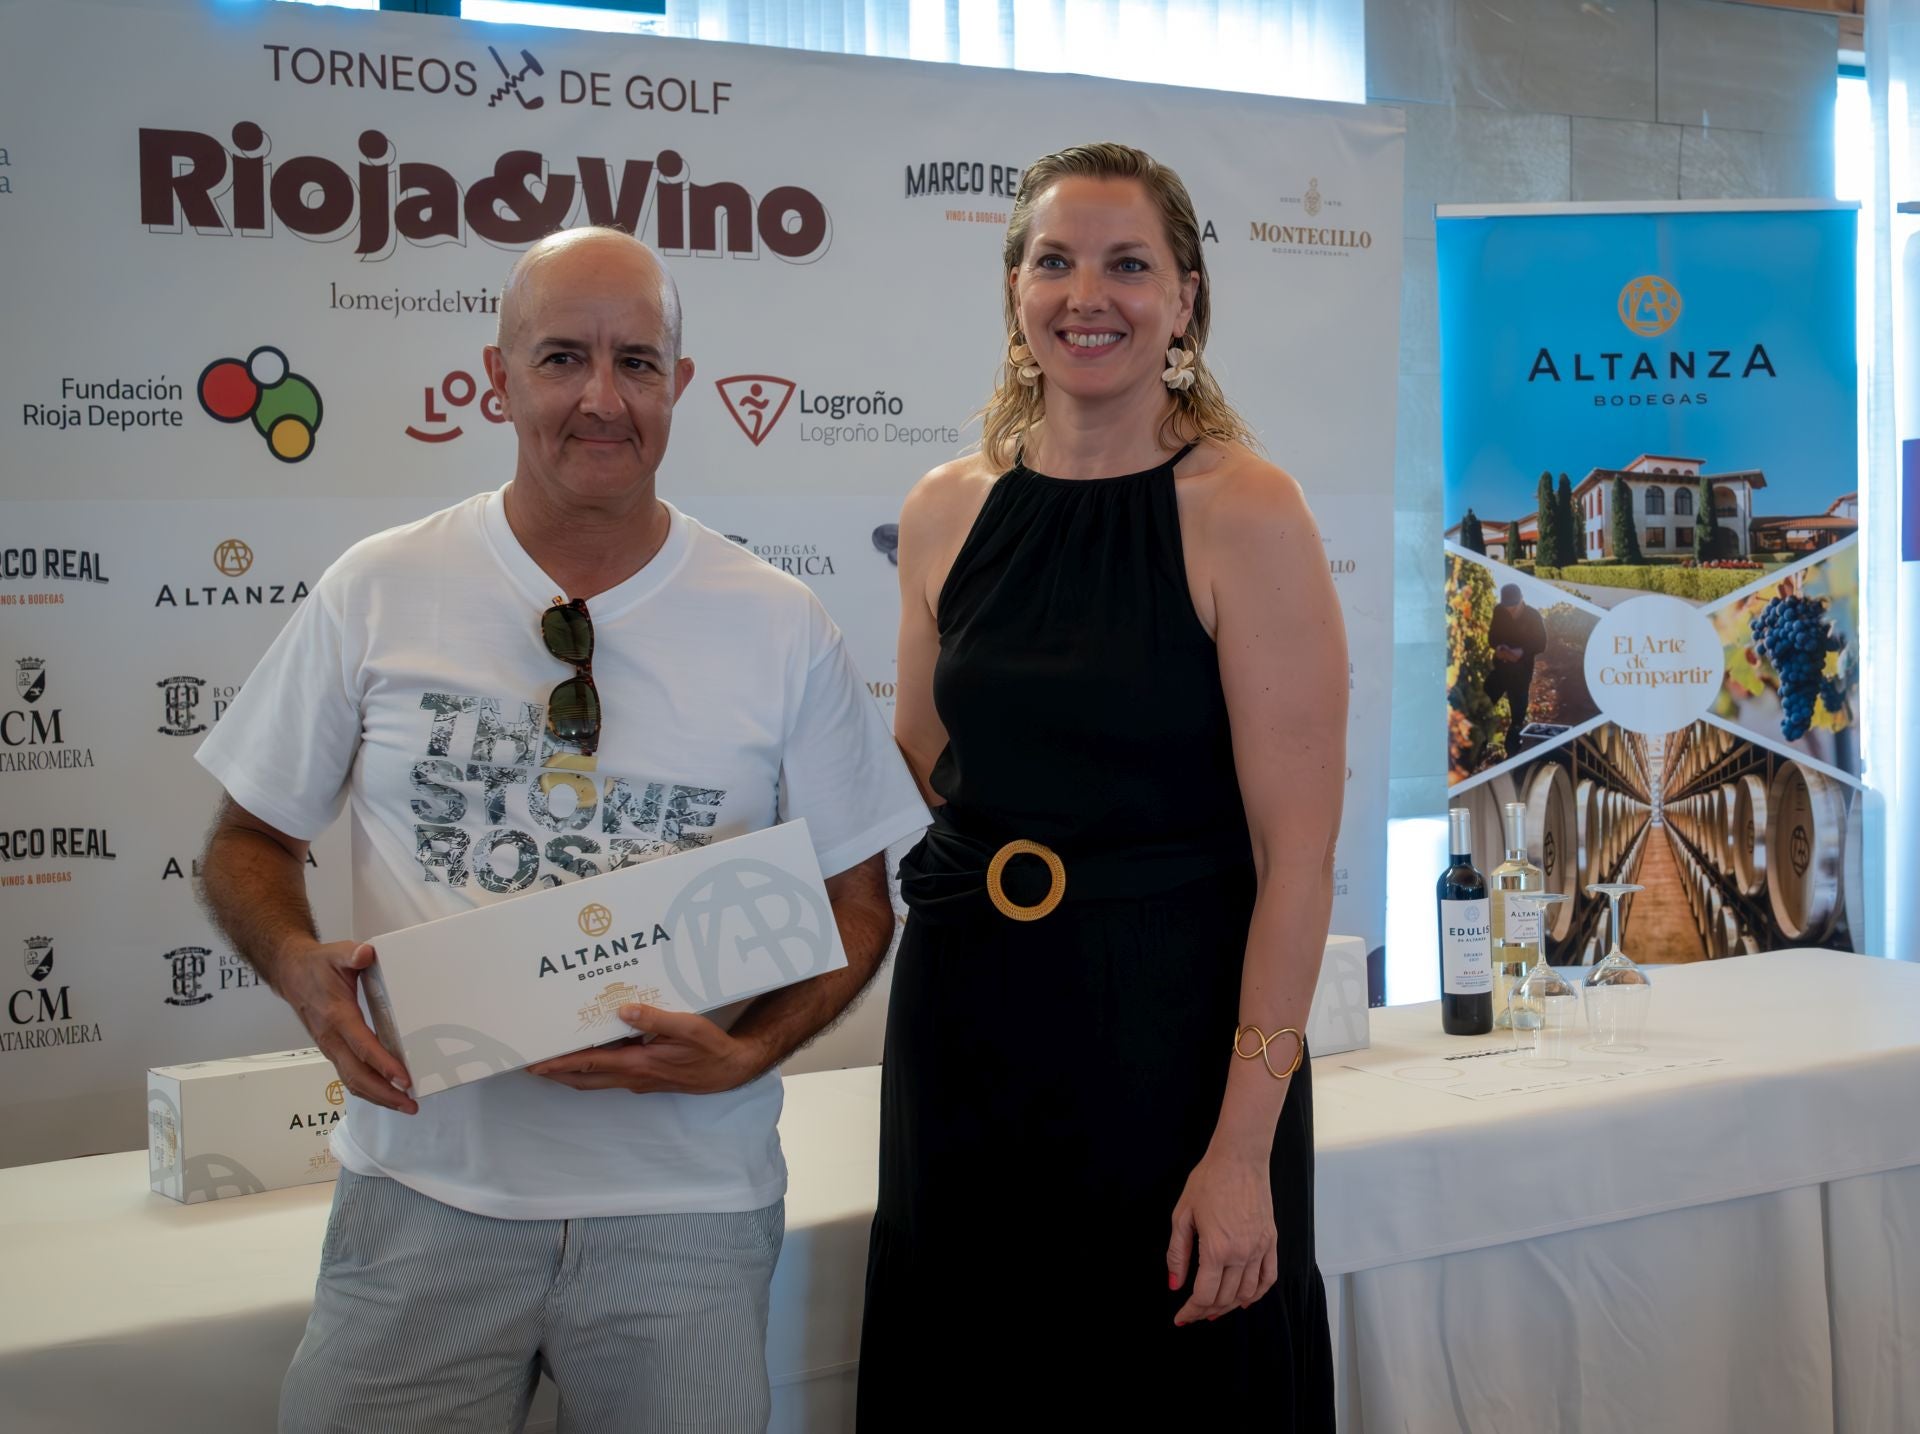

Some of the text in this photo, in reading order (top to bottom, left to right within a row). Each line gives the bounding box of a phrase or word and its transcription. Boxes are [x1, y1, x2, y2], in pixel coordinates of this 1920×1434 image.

[264, 45, 732, 115] TORNEOS DE GOLF
[905, 161, 1024, 199] MARCO RE
[1250, 221, 1372, 248] MONTECILLO
[1528, 343, 1776, 383] ALTANZA
[62, 375, 182, 400] Fundación
[1594, 392, 1709, 407] BODEGAS
[800, 389, 903, 420] Logroño
[23, 404, 183, 432] Rioja Deporte
[800, 422, 959, 446] Logroño Deporte
[753, 544, 817, 555] BODEGAS
[43, 547, 109, 584] REAL
[28, 593, 64, 604] BODEGAS
[155, 581, 309, 607] ALTANZA
[1614, 635, 1686, 654] El Arte
[1626, 654, 1648, 669] de
[1600, 666, 1712, 688] Compartir
[1, 709, 64, 746] CM
[409, 759, 728, 849] STONE
[51, 828, 116, 860] REAL
[1, 871, 72, 887] VINOS & BODEGAS
[1449, 925, 1489, 937] EDULIS
[538, 923, 671, 978] ALTANZA
[578, 957, 640, 981] BODEGAS
[8, 986, 72, 1025] CM
[289, 1110, 345, 1130] ALTA
